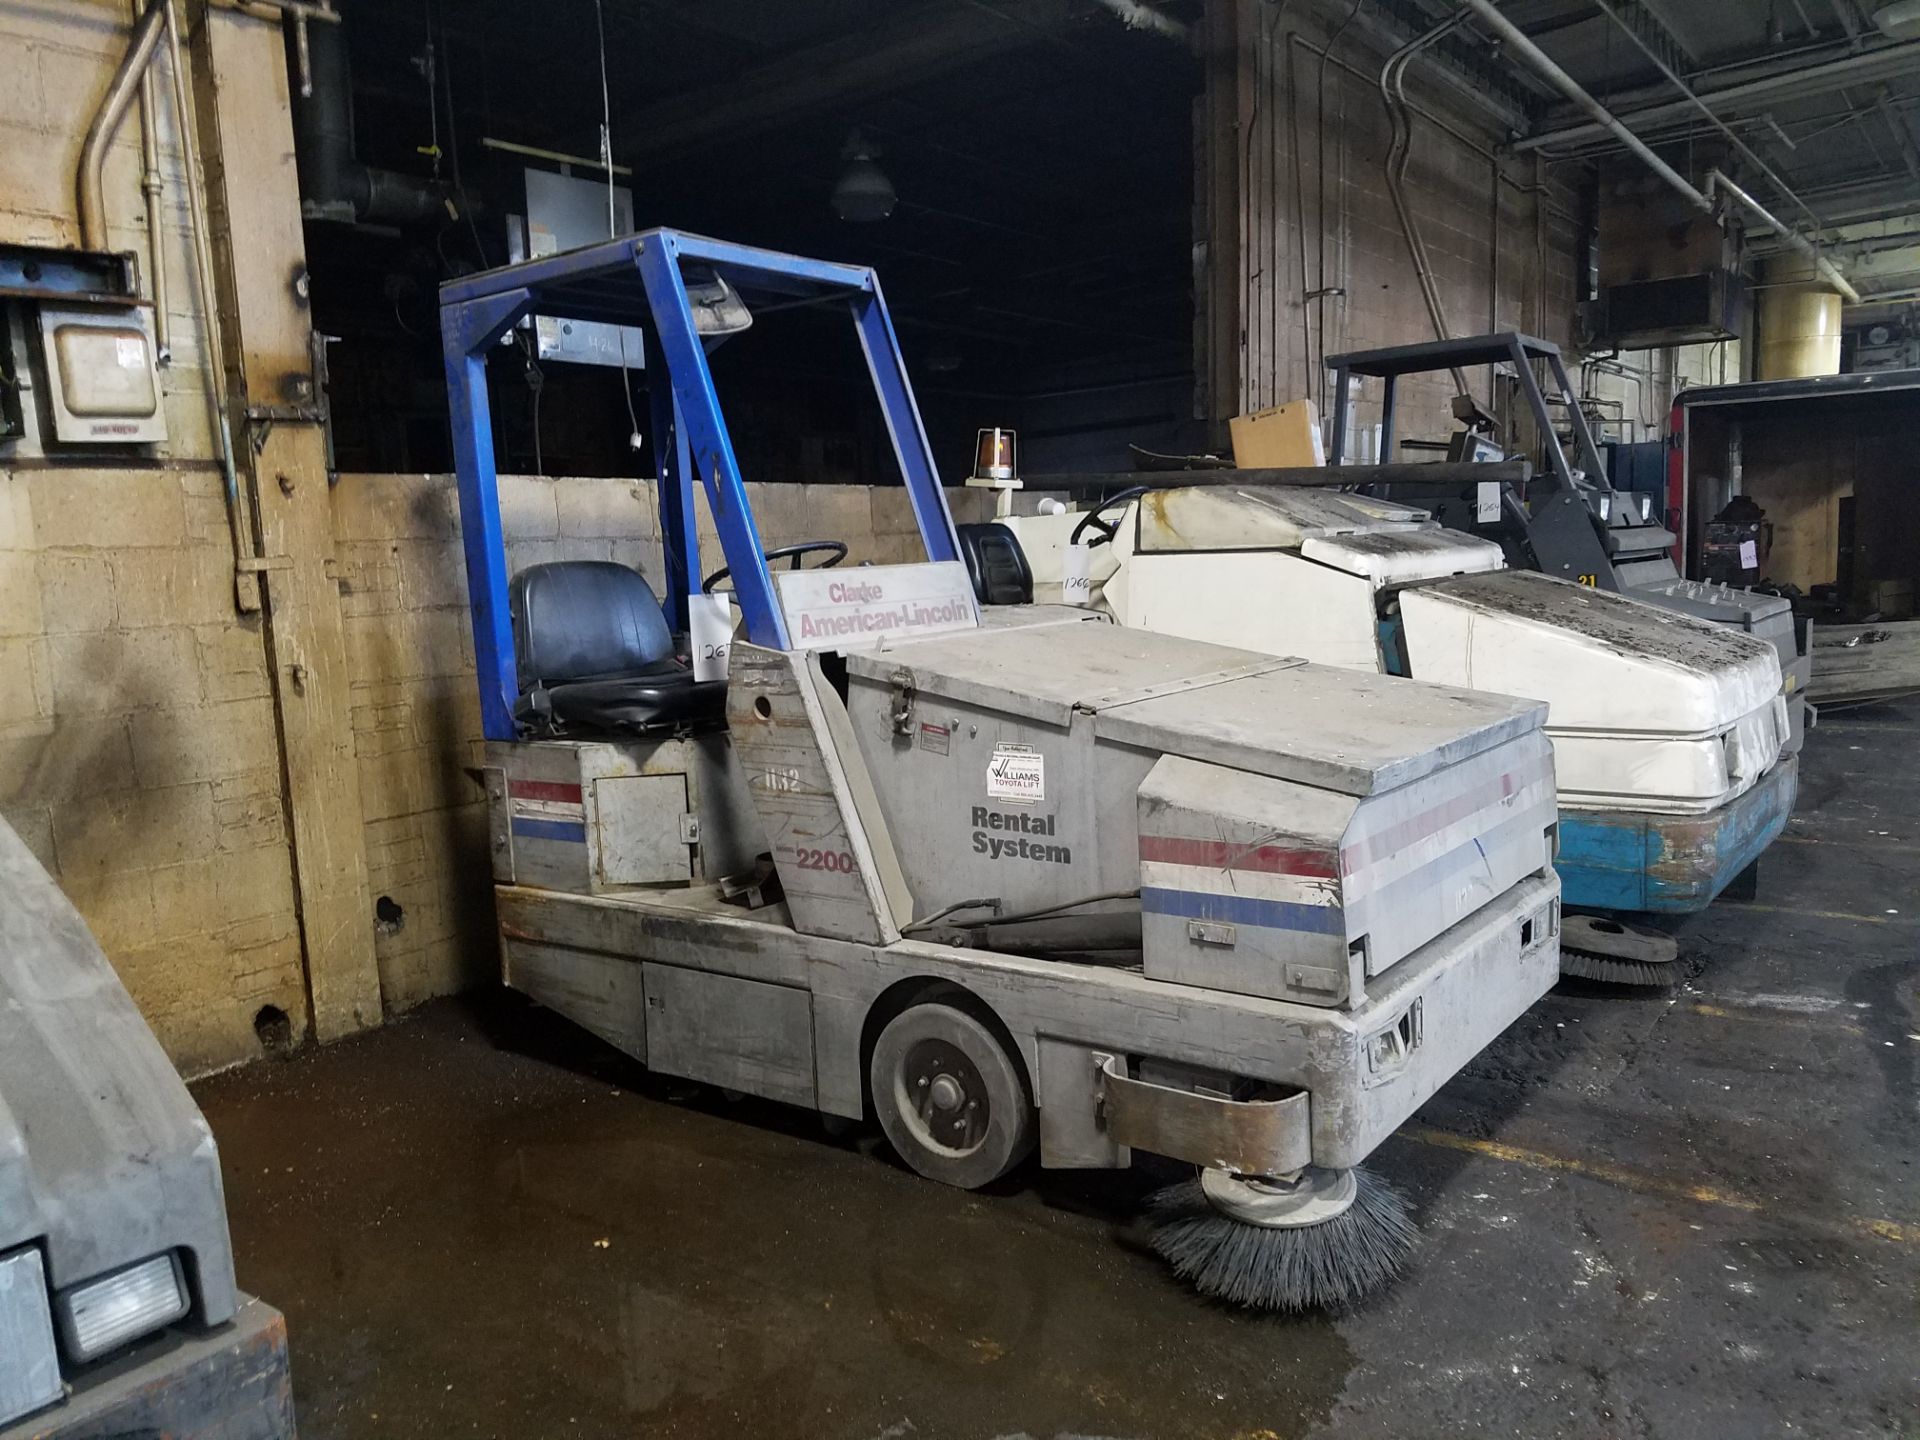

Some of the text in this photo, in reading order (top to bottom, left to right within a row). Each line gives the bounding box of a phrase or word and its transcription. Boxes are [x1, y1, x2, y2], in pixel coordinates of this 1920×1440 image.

[829, 582, 883, 604] Clarke
[1579, 575, 1596, 588] 21
[801, 598, 969, 638] American-Lincoln
[992, 759, 1040, 782] WILLIAMS
[995, 779, 1022, 787] TOYOTA
[972, 806, 1055, 836] Rental
[972, 831, 1071, 864] System
[797, 848, 853, 874] 2200
